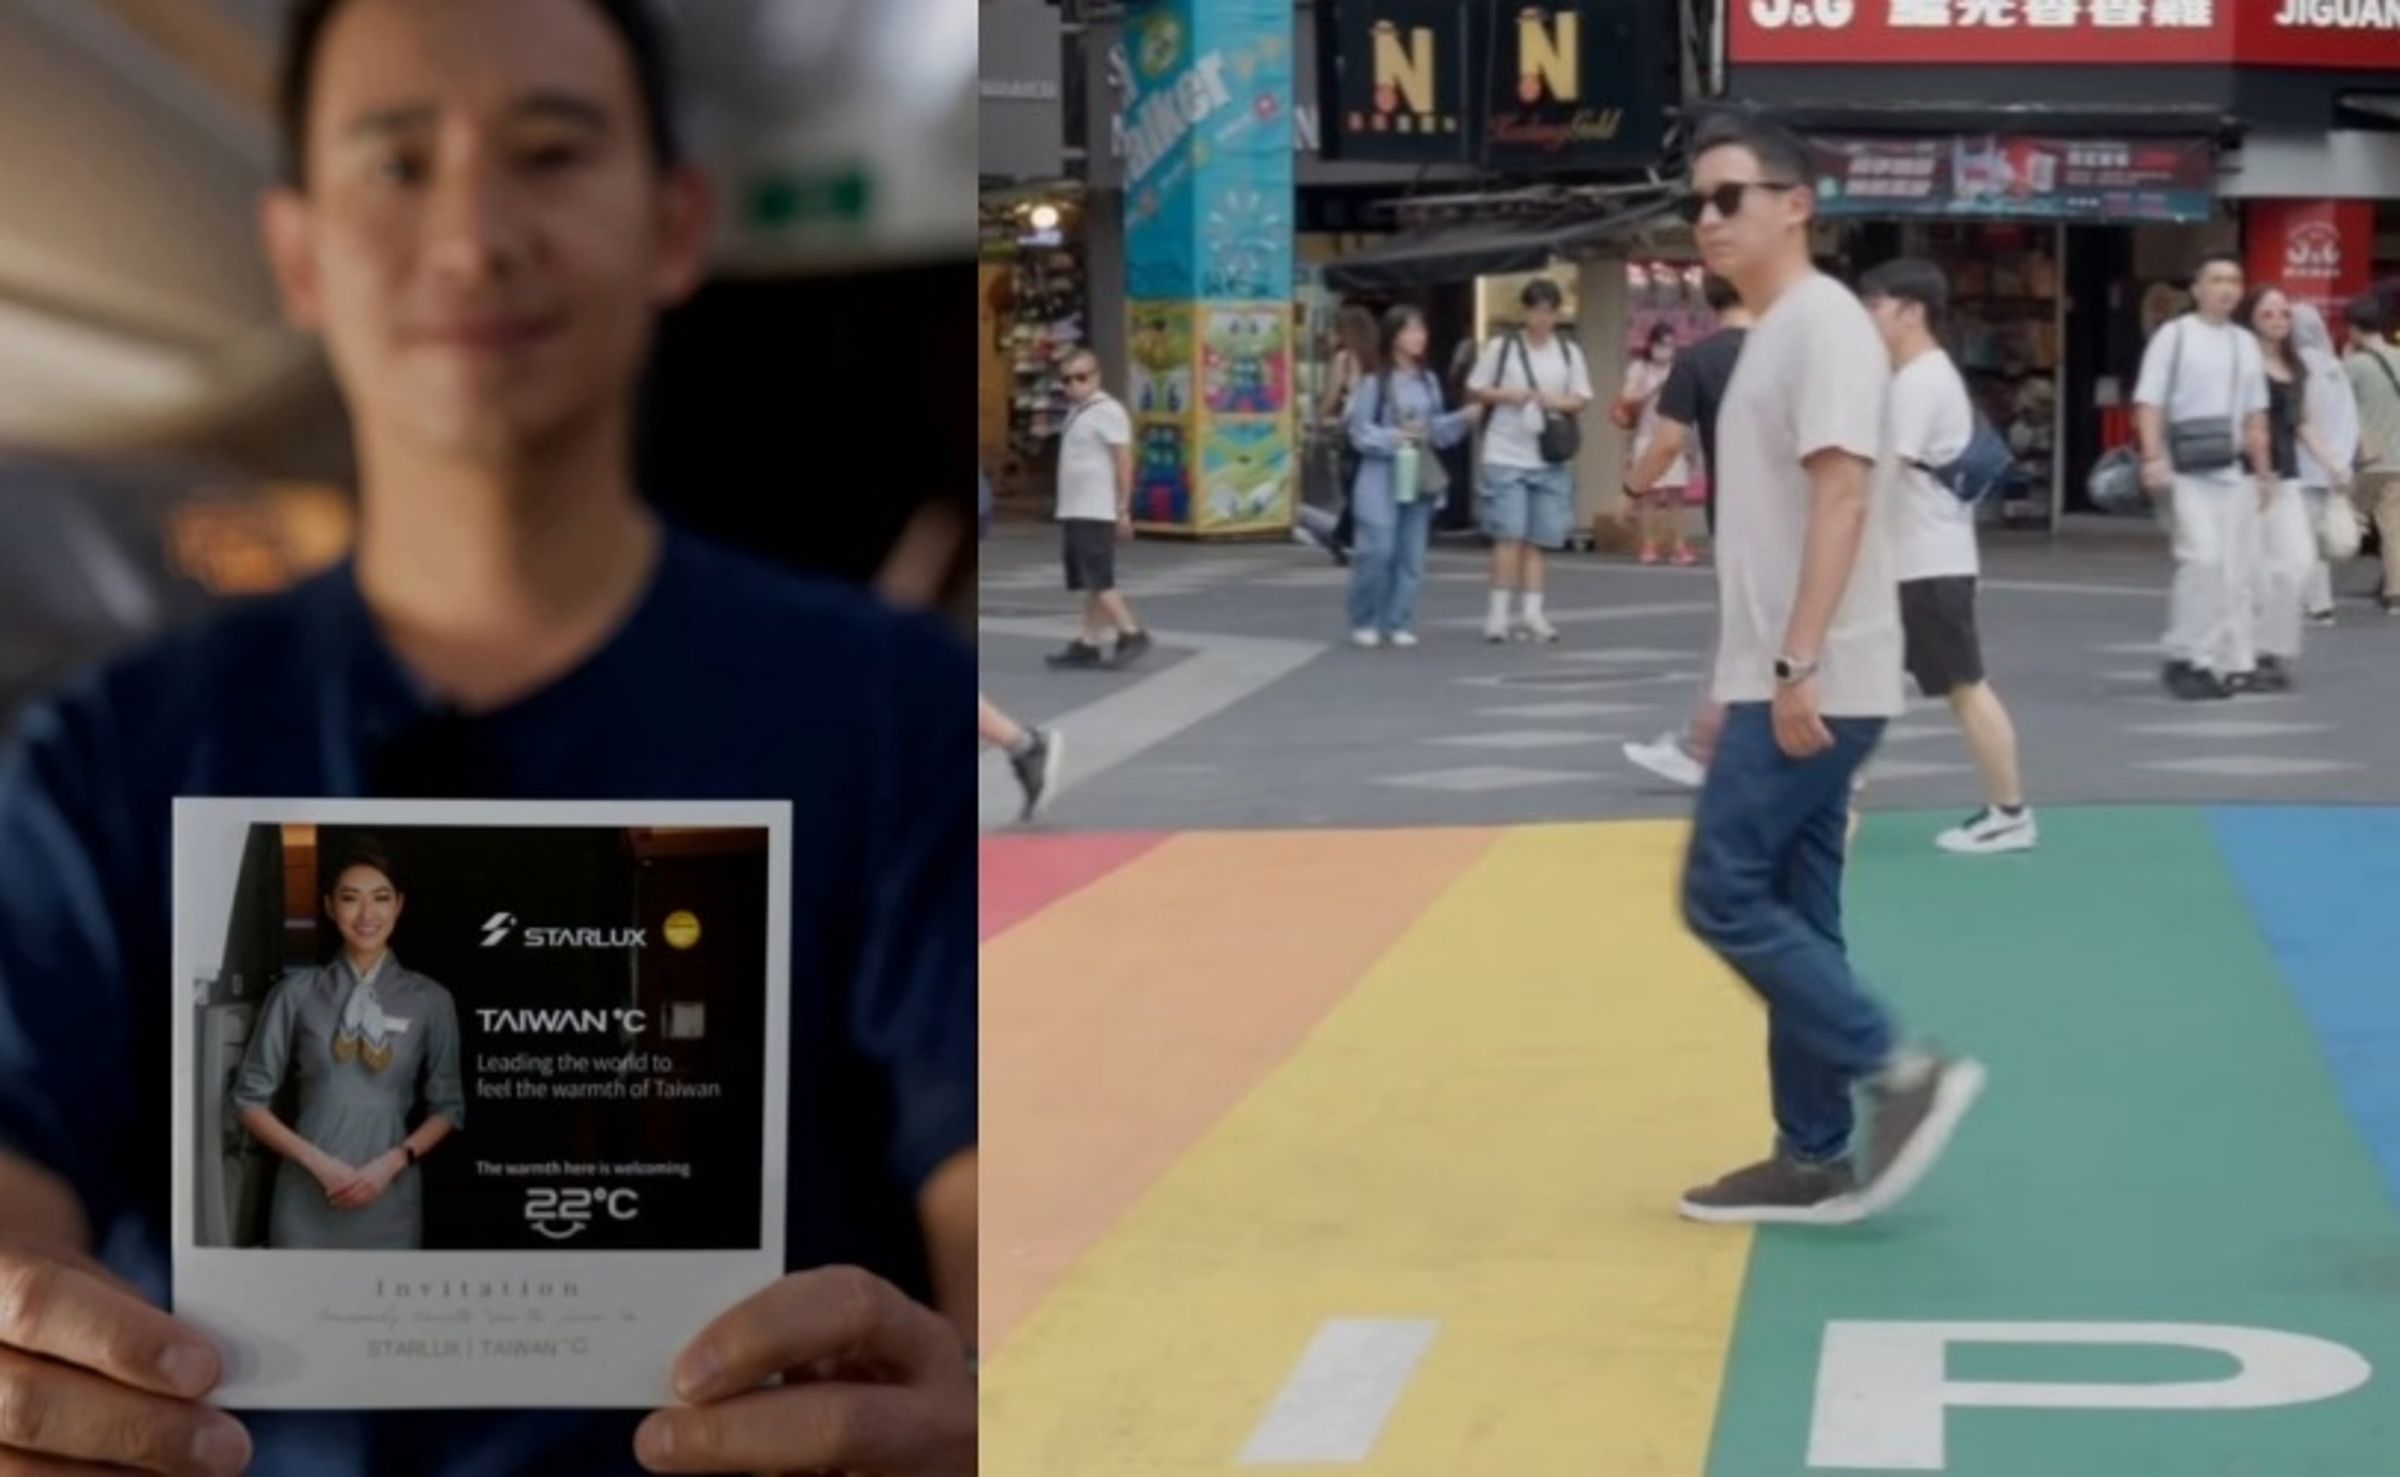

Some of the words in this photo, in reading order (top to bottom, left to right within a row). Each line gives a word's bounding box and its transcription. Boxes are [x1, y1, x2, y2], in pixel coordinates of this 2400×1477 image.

[524, 927, 647, 947] STARLUX
[476, 1009, 608, 1033] TAIWAN
[477, 1053, 554, 1076] Leading
[558, 1053, 589, 1072] the
[593, 1052, 648, 1073] world
[652, 1055, 673, 1073] to
[477, 1078, 511, 1098] feel
[516, 1079, 548, 1098] the
[552, 1079, 626, 1098] warmth
[629, 1078, 650, 1098] of
[655, 1079, 720, 1098] Taiwan
[476, 1160, 502, 1175] The
[504, 1160, 563, 1175] warmth
[564, 1160, 596, 1175] here
[600, 1161, 610, 1175] is
[614, 1160, 691, 1178] welcoming
[376, 1278, 580, 1298] Invitation
[366, 1338, 461, 1359] STARLUX
